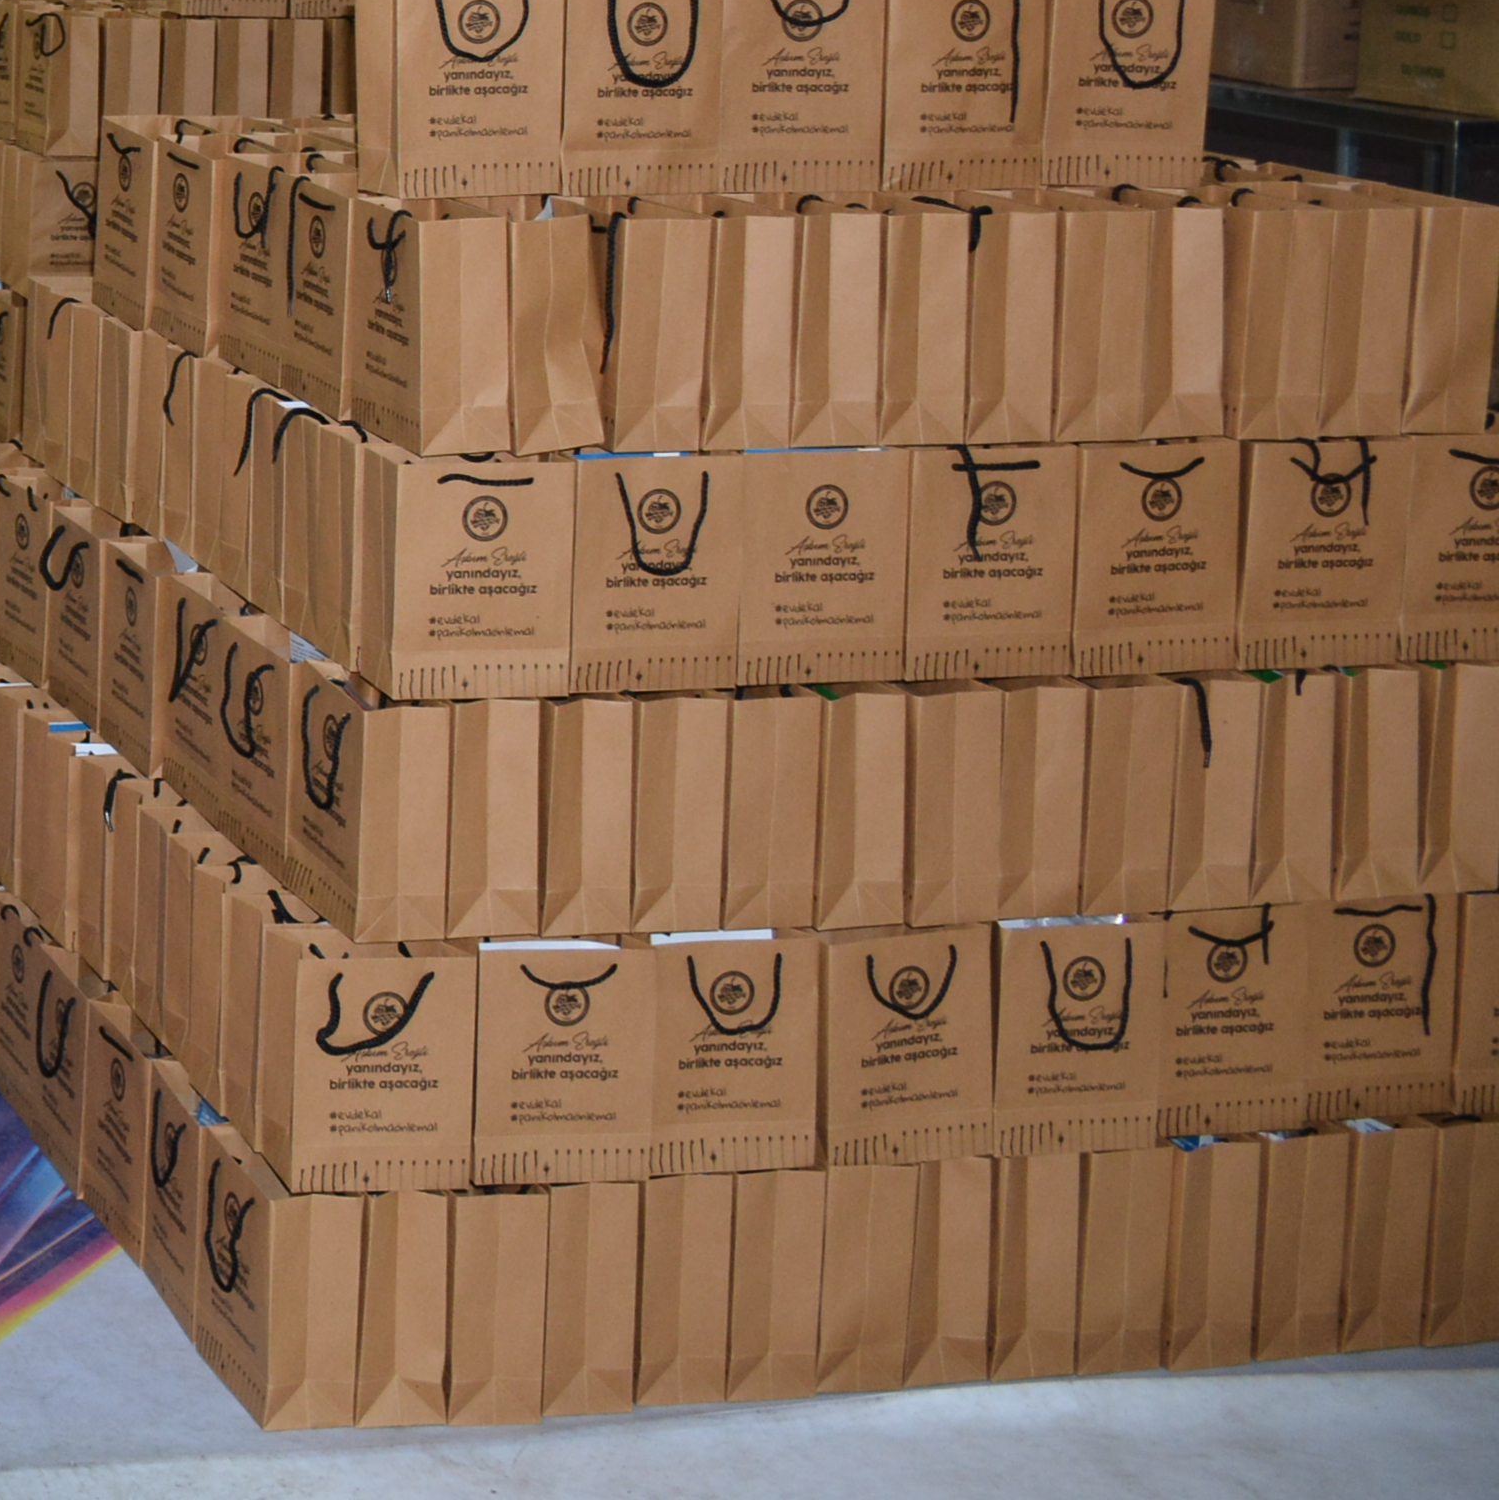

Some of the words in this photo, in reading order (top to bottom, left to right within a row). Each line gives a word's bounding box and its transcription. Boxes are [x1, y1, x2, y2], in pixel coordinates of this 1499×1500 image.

[766, 67, 834, 79] yanındayız,
[751, 81, 792, 92] birlikte
[795, 81, 849, 94] aşacağız
[1125, 546, 1192, 560] yanındayız,
[789, 555, 859, 568] yanındayız,
[1110, 562, 1150, 574] birlikte
[1153, 559, 1206, 574] aşacağız
[445, 567, 521, 581] yanındayız,
[774, 571, 817, 582] birlikte
[820, 570, 874, 584] aşacağız
[429, 583, 474, 594] birlikte
[477, 582, 537, 596] aşacağız
[774, 602, 822, 612] #evdekal
[428, 614, 479, 624] #evdekal
[1190, 1007, 1259, 1022] yanındayız,
[1175, 1024, 1217, 1035] birlikte
[1220, 1021, 1274, 1035] aşacağız
[527, 1052, 602, 1065] yanındayız,
[510, 1068, 556, 1079] birlikte
[559, 1067, 618, 1081] aşacağız
[510, 1098, 561, 1108] #evdekal
